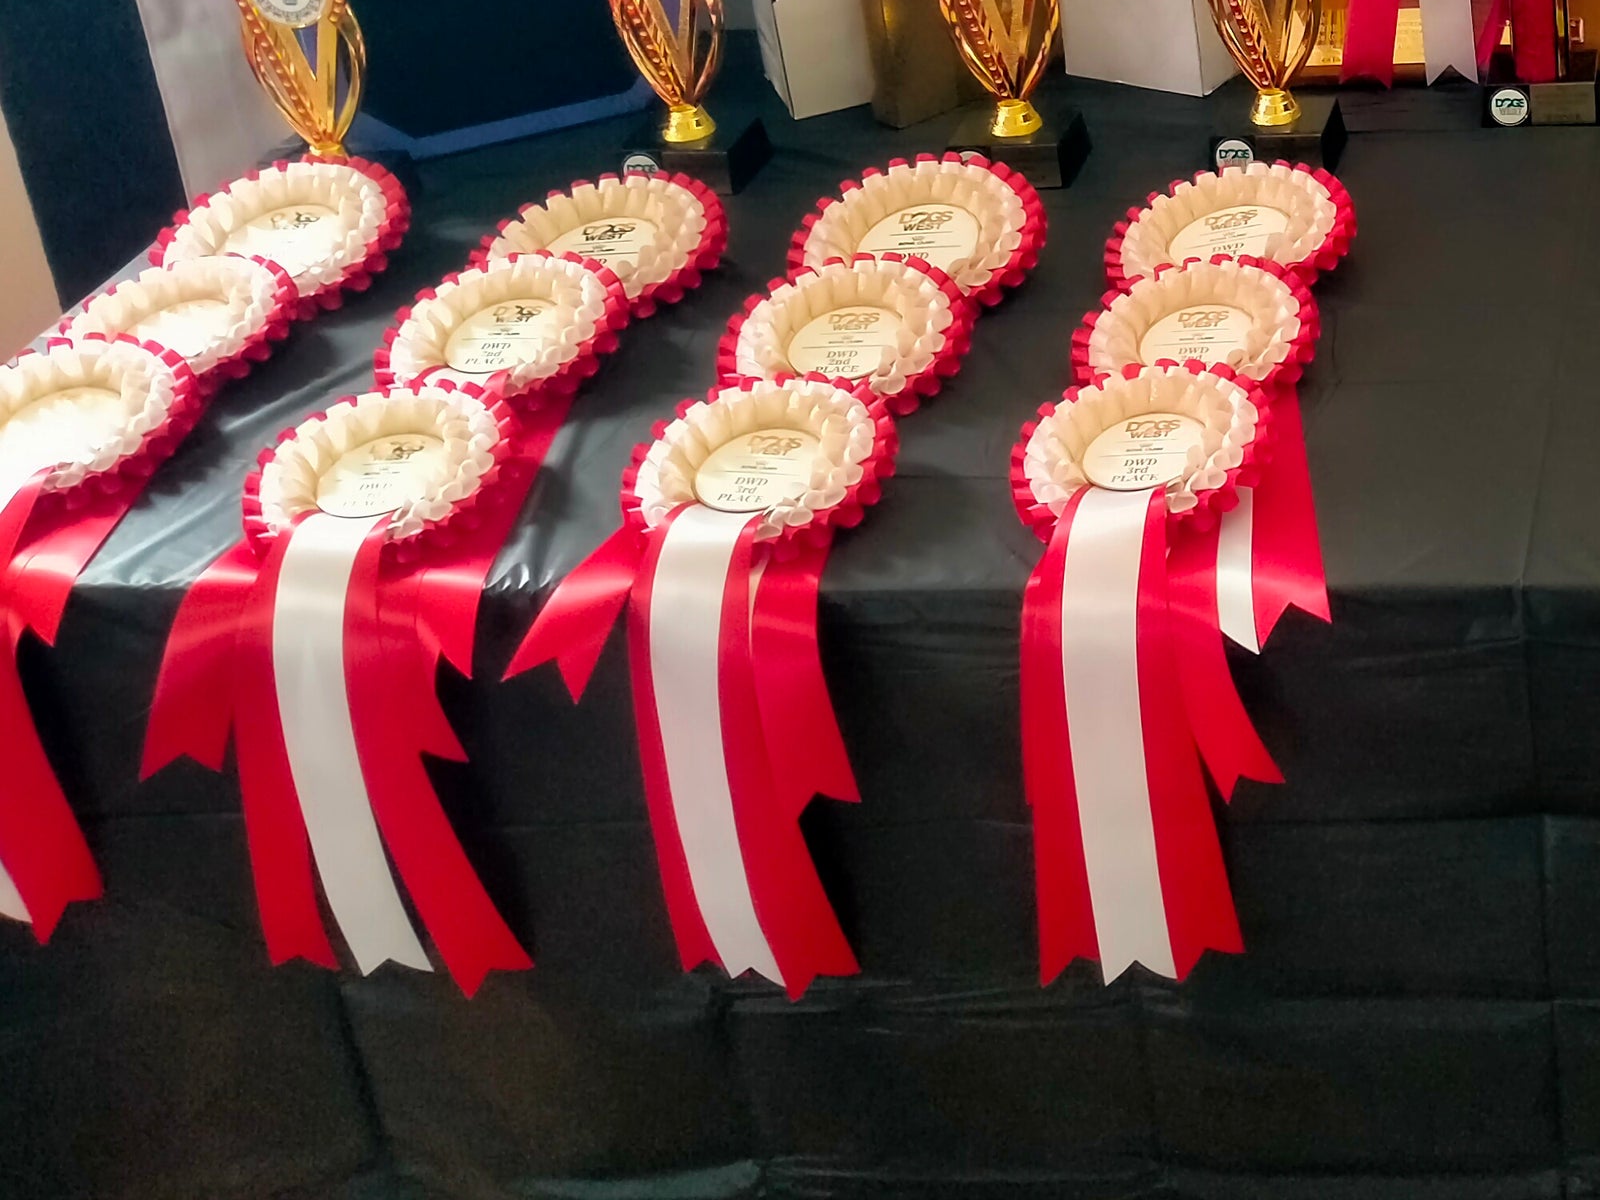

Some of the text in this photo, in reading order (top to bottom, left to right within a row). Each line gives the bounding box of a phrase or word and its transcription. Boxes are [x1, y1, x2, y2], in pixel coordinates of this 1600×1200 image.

[903, 222, 944, 231] WEST
[585, 232, 627, 241] WEST
[1212, 243, 1245, 252] DWD
[832, 323, 873, 331] WEST
[480, 342, 511, 350] DWD
[826, 350, 859, 359] DWD
[1178, 347, 1210, 355] DWD
[828, 358, 851, 366] 2nd
[815, 365, 860, 374] PLACE
[1130, 431, 1170, 439] WEST
[1123, 458, 1158, 467] DWD
[1126, 466, 1149, 474] 3rd
[735, 477, 768, 486] DWD
[1111, 474, 1159, 482] PLACE
[736, 486, 757, 494] 3rd
[717, 493, 763, 502] PLACE
